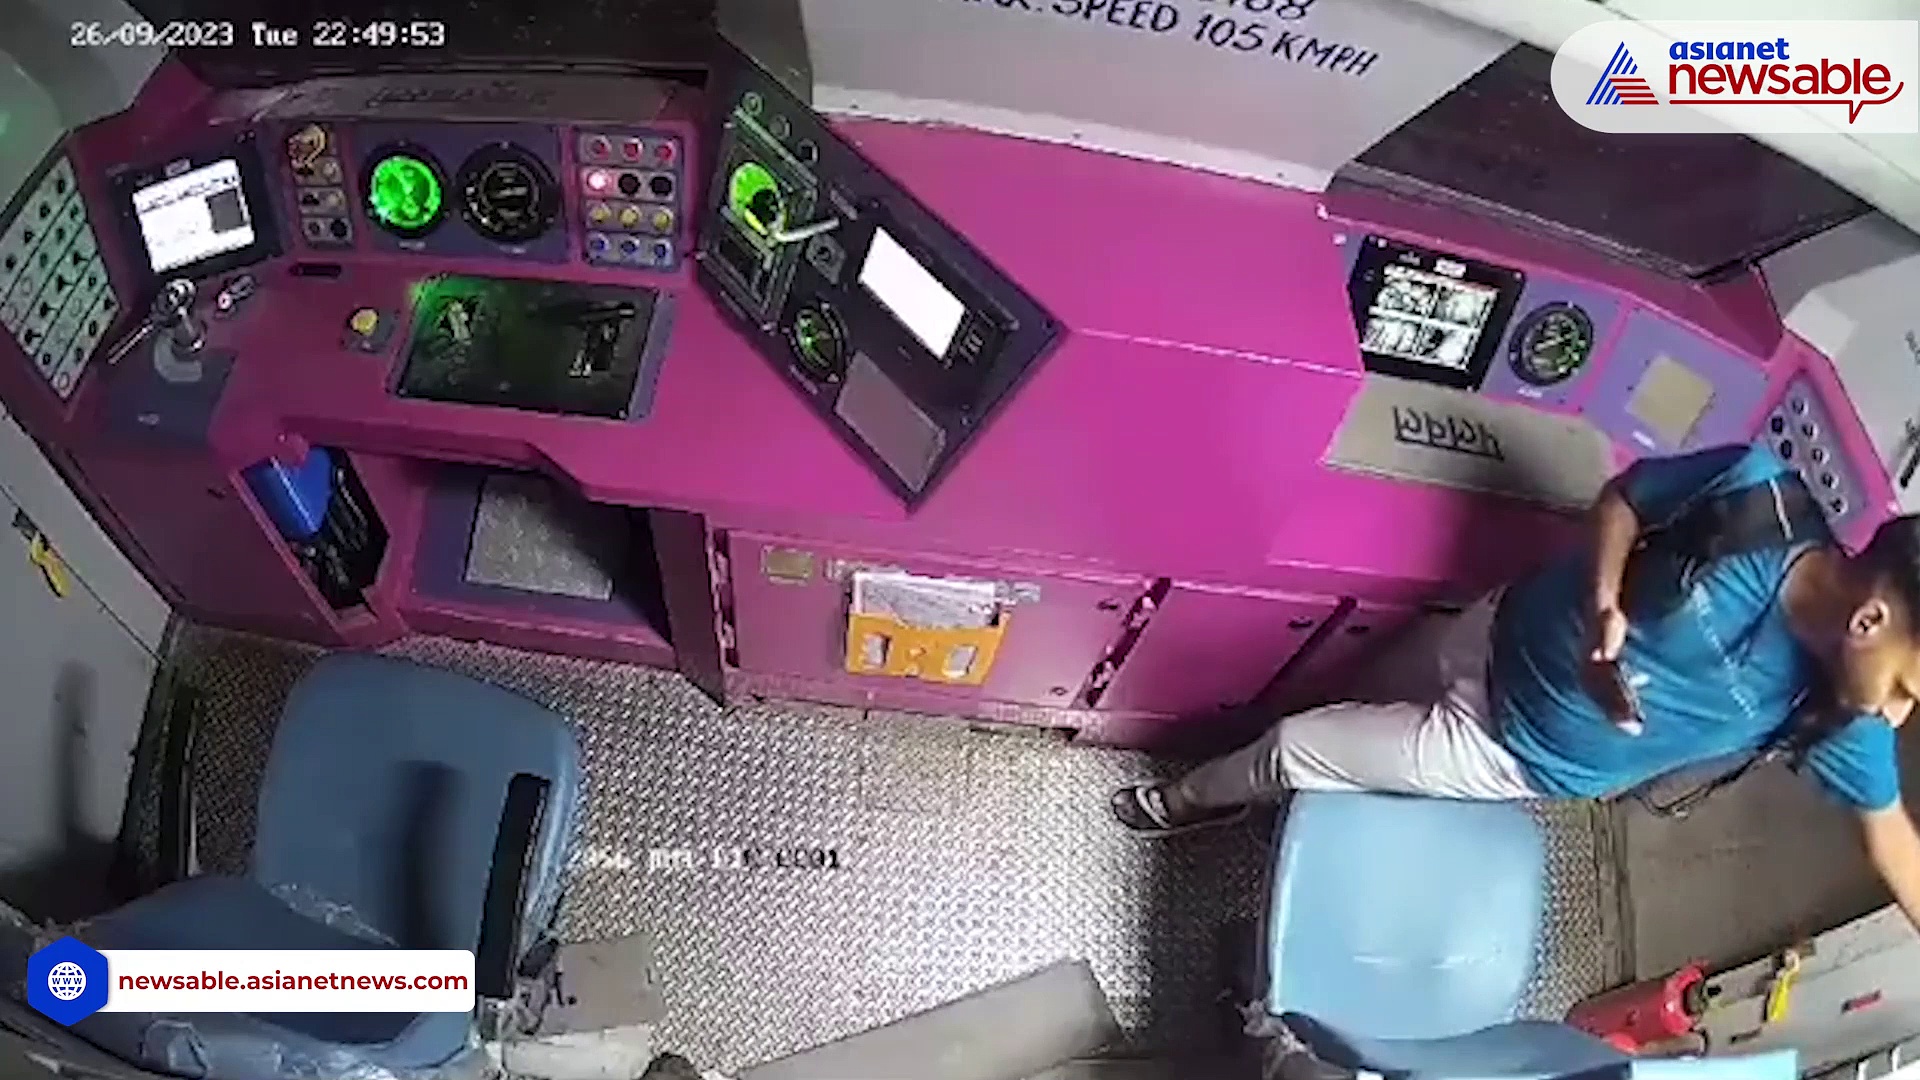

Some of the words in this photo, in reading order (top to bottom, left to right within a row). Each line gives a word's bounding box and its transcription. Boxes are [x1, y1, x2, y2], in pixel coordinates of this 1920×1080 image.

[1052, 0, 1179, 32] SPEED
[1194, 14, 1268, 51] 105
[1271, 31, 1379, 76] KMPH
